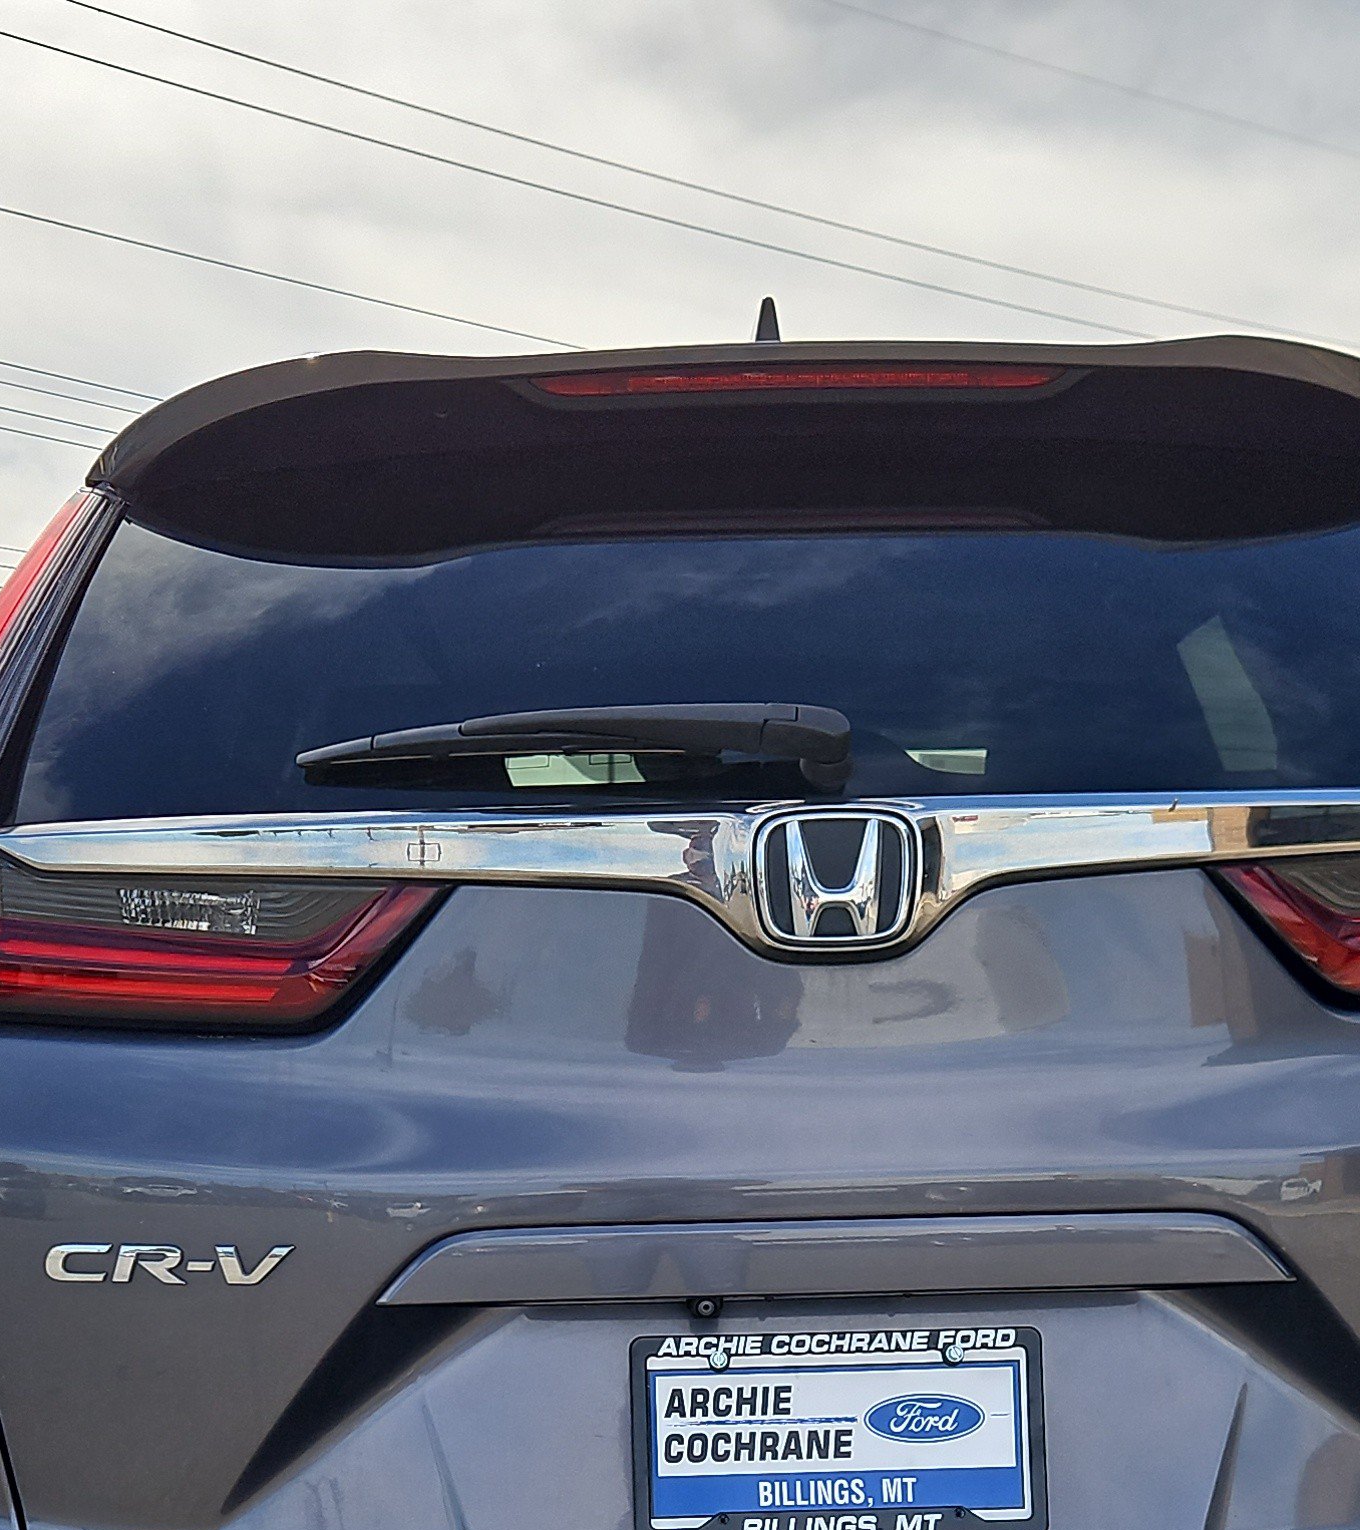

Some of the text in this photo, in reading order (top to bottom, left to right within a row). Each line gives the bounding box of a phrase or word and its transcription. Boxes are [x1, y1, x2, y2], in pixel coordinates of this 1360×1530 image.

[45, 1243, 295, 1285] CR-V
[657, 1327, 1017, 1358] ARCHIE COCHRANE FORD
[663, 1384, 793, 1420] ARCHIE
[889, 1404, 959, 1434] Ford
[663, 1428, 854, 1465] COCHRANE
[758, 1476, 917, 1509] BILLINGS, MT
